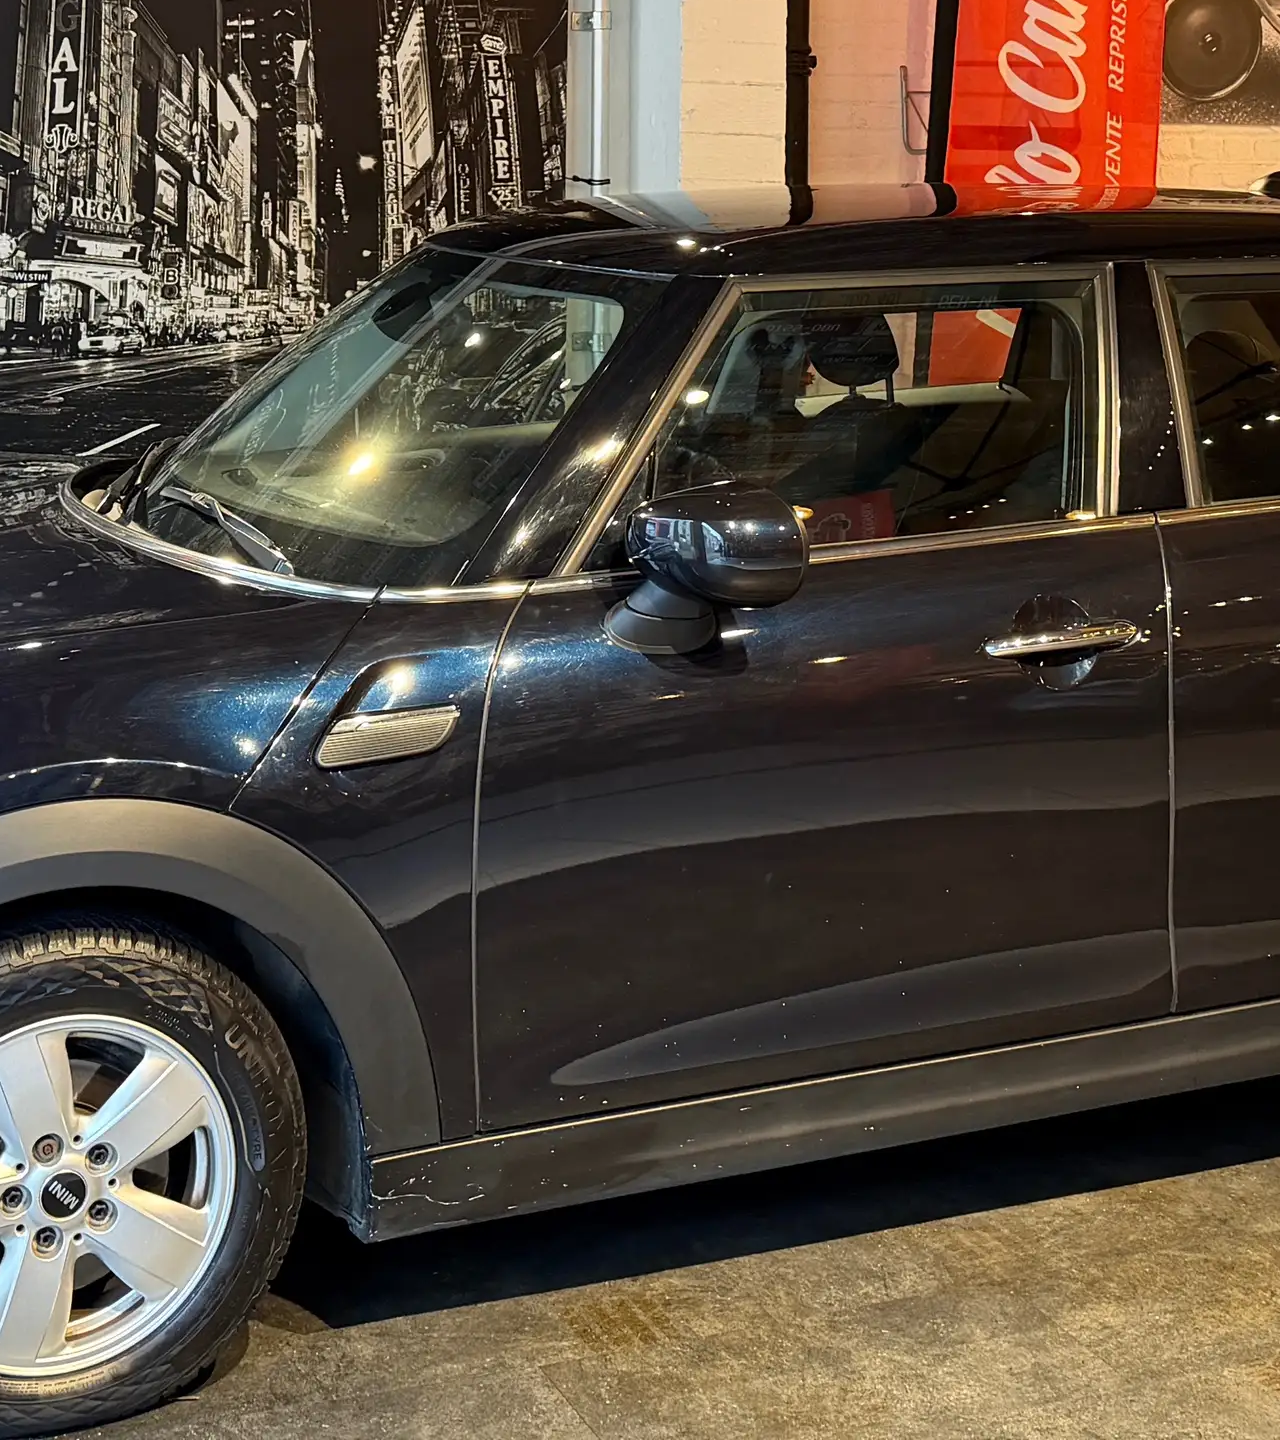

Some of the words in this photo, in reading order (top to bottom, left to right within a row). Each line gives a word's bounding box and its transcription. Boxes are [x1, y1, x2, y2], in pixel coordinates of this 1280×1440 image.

[486, 59, 511, 180] EMPIRE
[1104, 111, 1123, 188] VENTE
[47, 1179, 80, 1212] MINI
